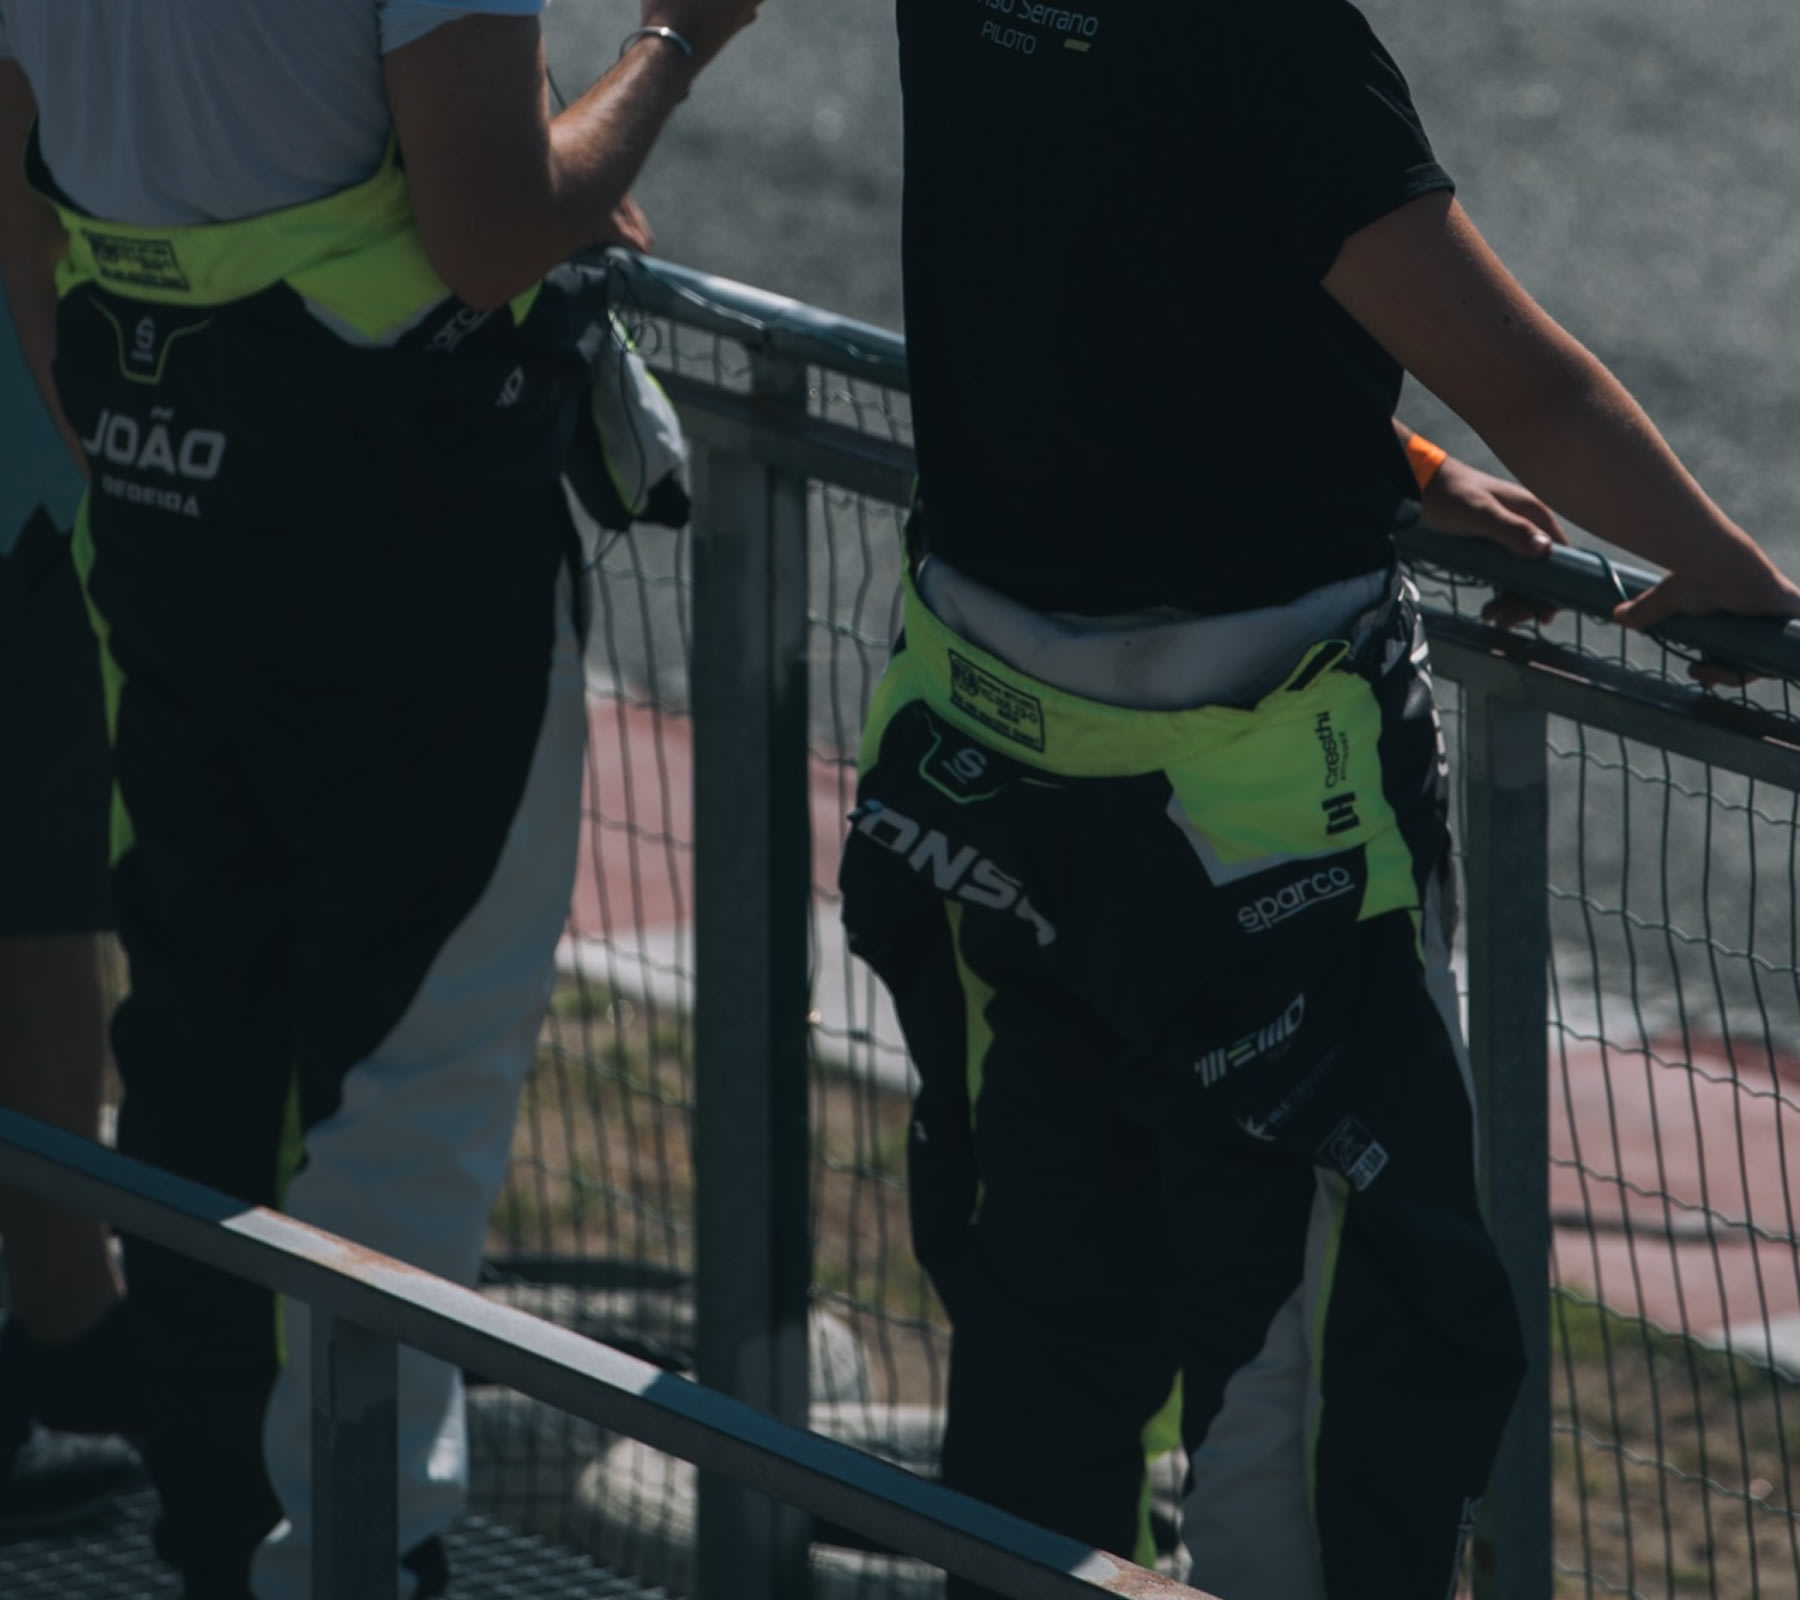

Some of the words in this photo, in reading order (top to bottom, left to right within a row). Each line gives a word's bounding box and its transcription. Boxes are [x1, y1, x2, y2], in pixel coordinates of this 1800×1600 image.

[980, 20, 1037, 55] PILOTO
[81, 404, 227, 481] JOÃO
[1236, 865, 1350, 930] sparco
